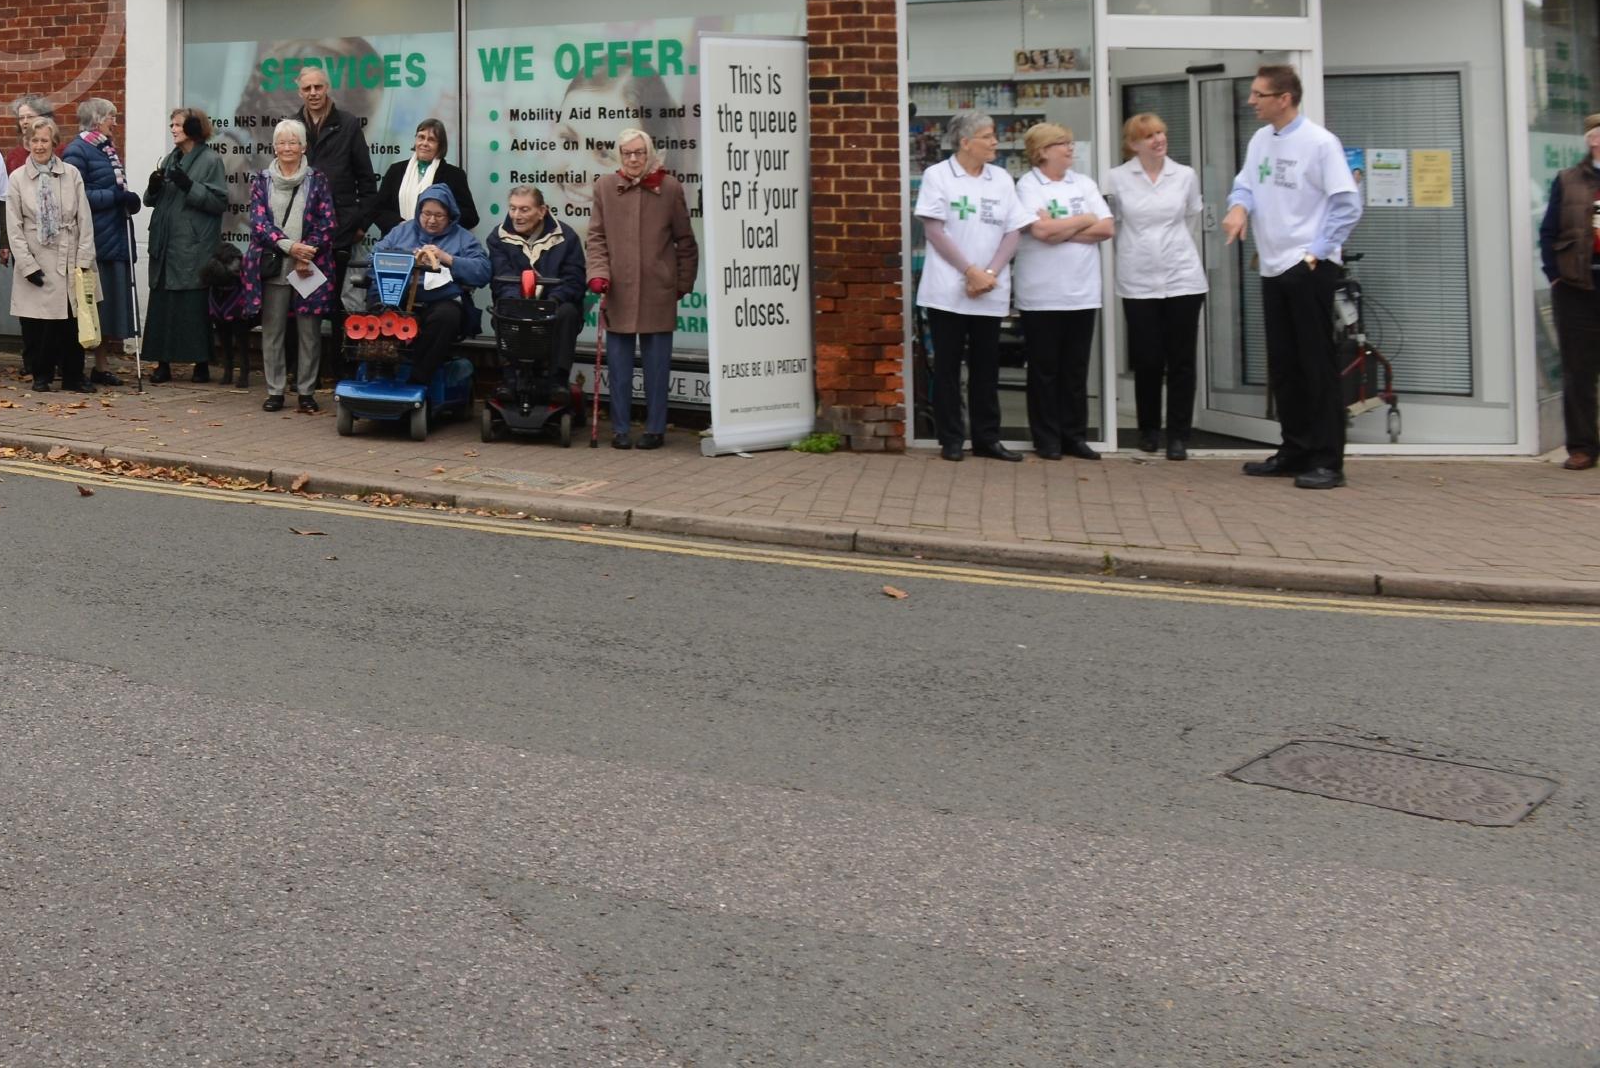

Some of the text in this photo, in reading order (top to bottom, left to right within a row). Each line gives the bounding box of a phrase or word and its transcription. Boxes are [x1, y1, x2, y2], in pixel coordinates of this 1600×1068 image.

[478, 46, 534, 82] WE
[729, 65, 781, 94] This is
[234, 115, 257, 127] NHS
[510, 105, 686, 123] Mobility Aid Rentals and
[717, 103, 797, 139] the queue
[232, 143, 252, 155] and
[510, 138, 556, 151] Advice
[563, 140, 578, 150] on
[586, 137, 615, 150] New
[726, 142, 790, 177] for your
[510, 170, 587, 183] Residential
[721, 181, 742, 211] GP
[747, 181, 758, 209] if
[763, 187, 799, 216] your
[741, 218, 779, 249] local
[723, 259, 800, 295] pharmacy
[735, 297, 790, 328] closes.
[722, 358, 808, 379] PLEASE BE (A) PATIENT
